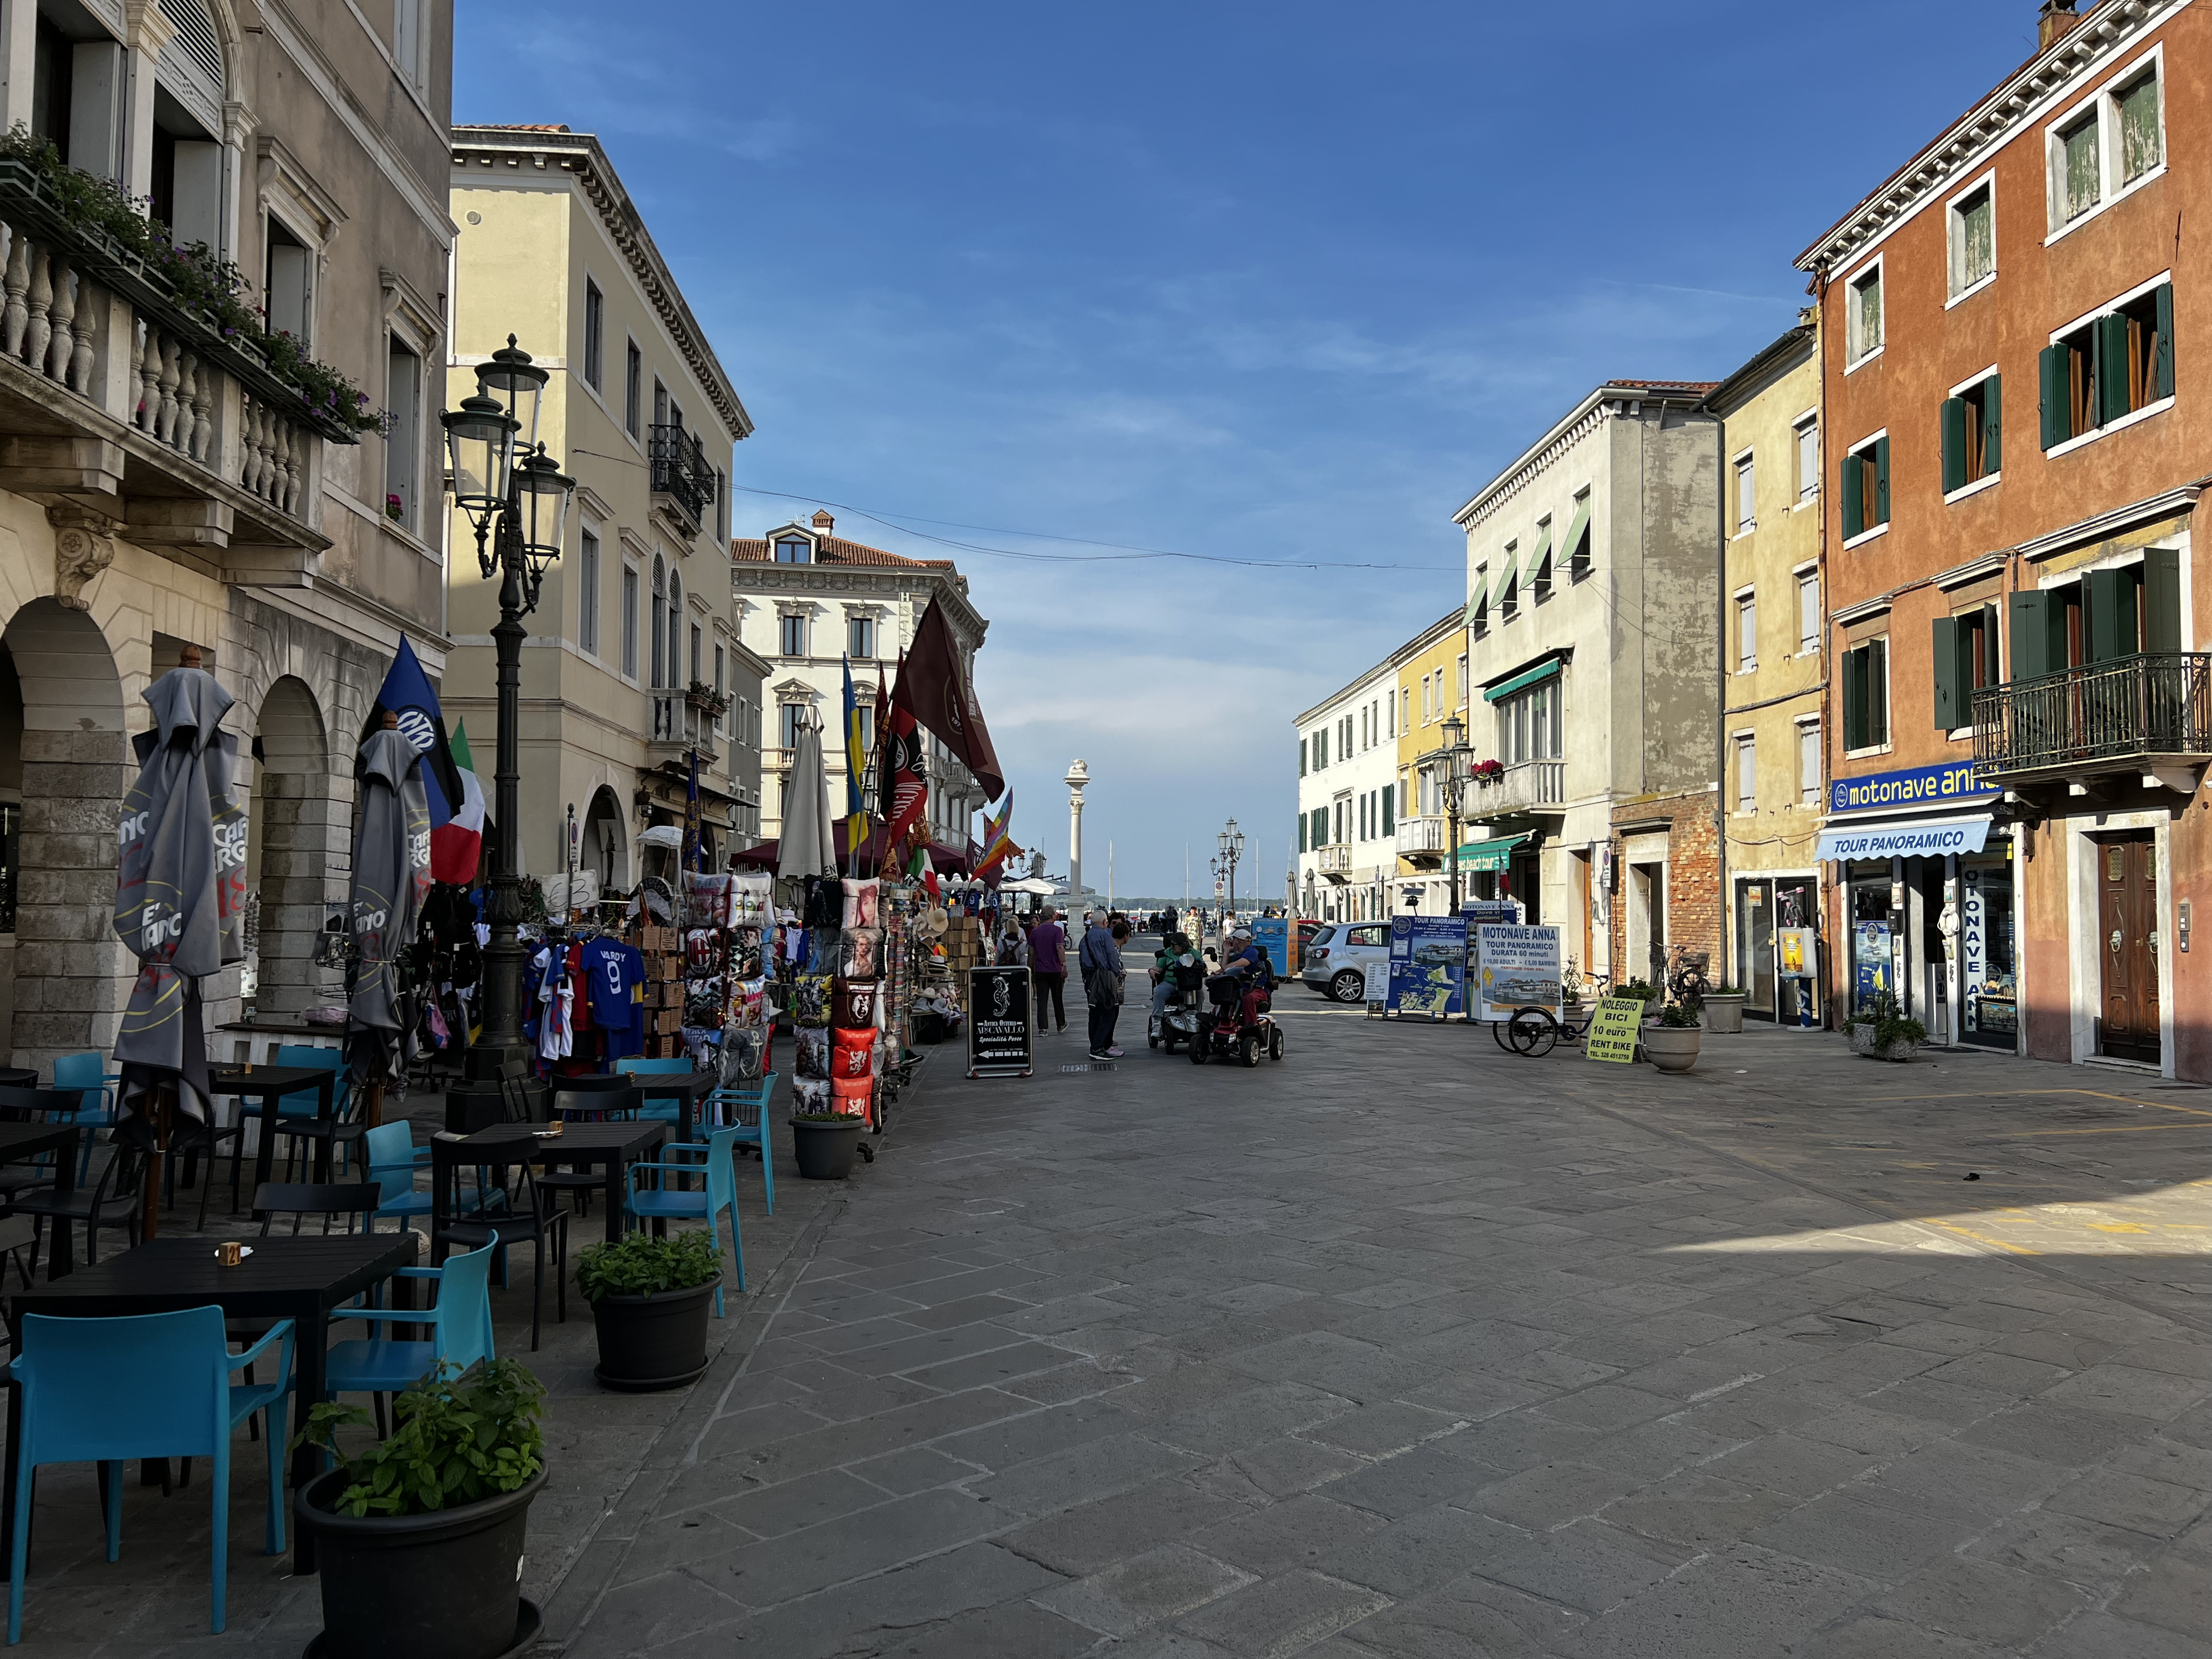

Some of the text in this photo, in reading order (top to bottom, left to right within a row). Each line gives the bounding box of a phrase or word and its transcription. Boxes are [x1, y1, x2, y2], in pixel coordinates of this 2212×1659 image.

[901, 592, 911, 645] HOTE
[1849, 776, 1936, 806] motonave
[1834, 831, 1964, 853] TOUR PANORAMICO
[824, 864, 837, 877] EN
[1964, 869, 1981, 973] OTONAVE
[1483, 927, 1556, 941] MOTONAVE ANNA
[1507, 942, 1553, 950] PANORAMICO
[600, 951, 626, 962] VARDY
[607, 961, 622, 994] 9
[1600, 999, 1638, 1011] NOLEGGIO
[1605, 1013, 1628, 1022] BICI
[988, 1025, 1024, 1034] CAVALLO
[1593, 1025, 1626, 1037] 10 euro
[1590, 1040, 1631, 1051] RENT BIKE
[229, 1244, 241, 1264] 21
